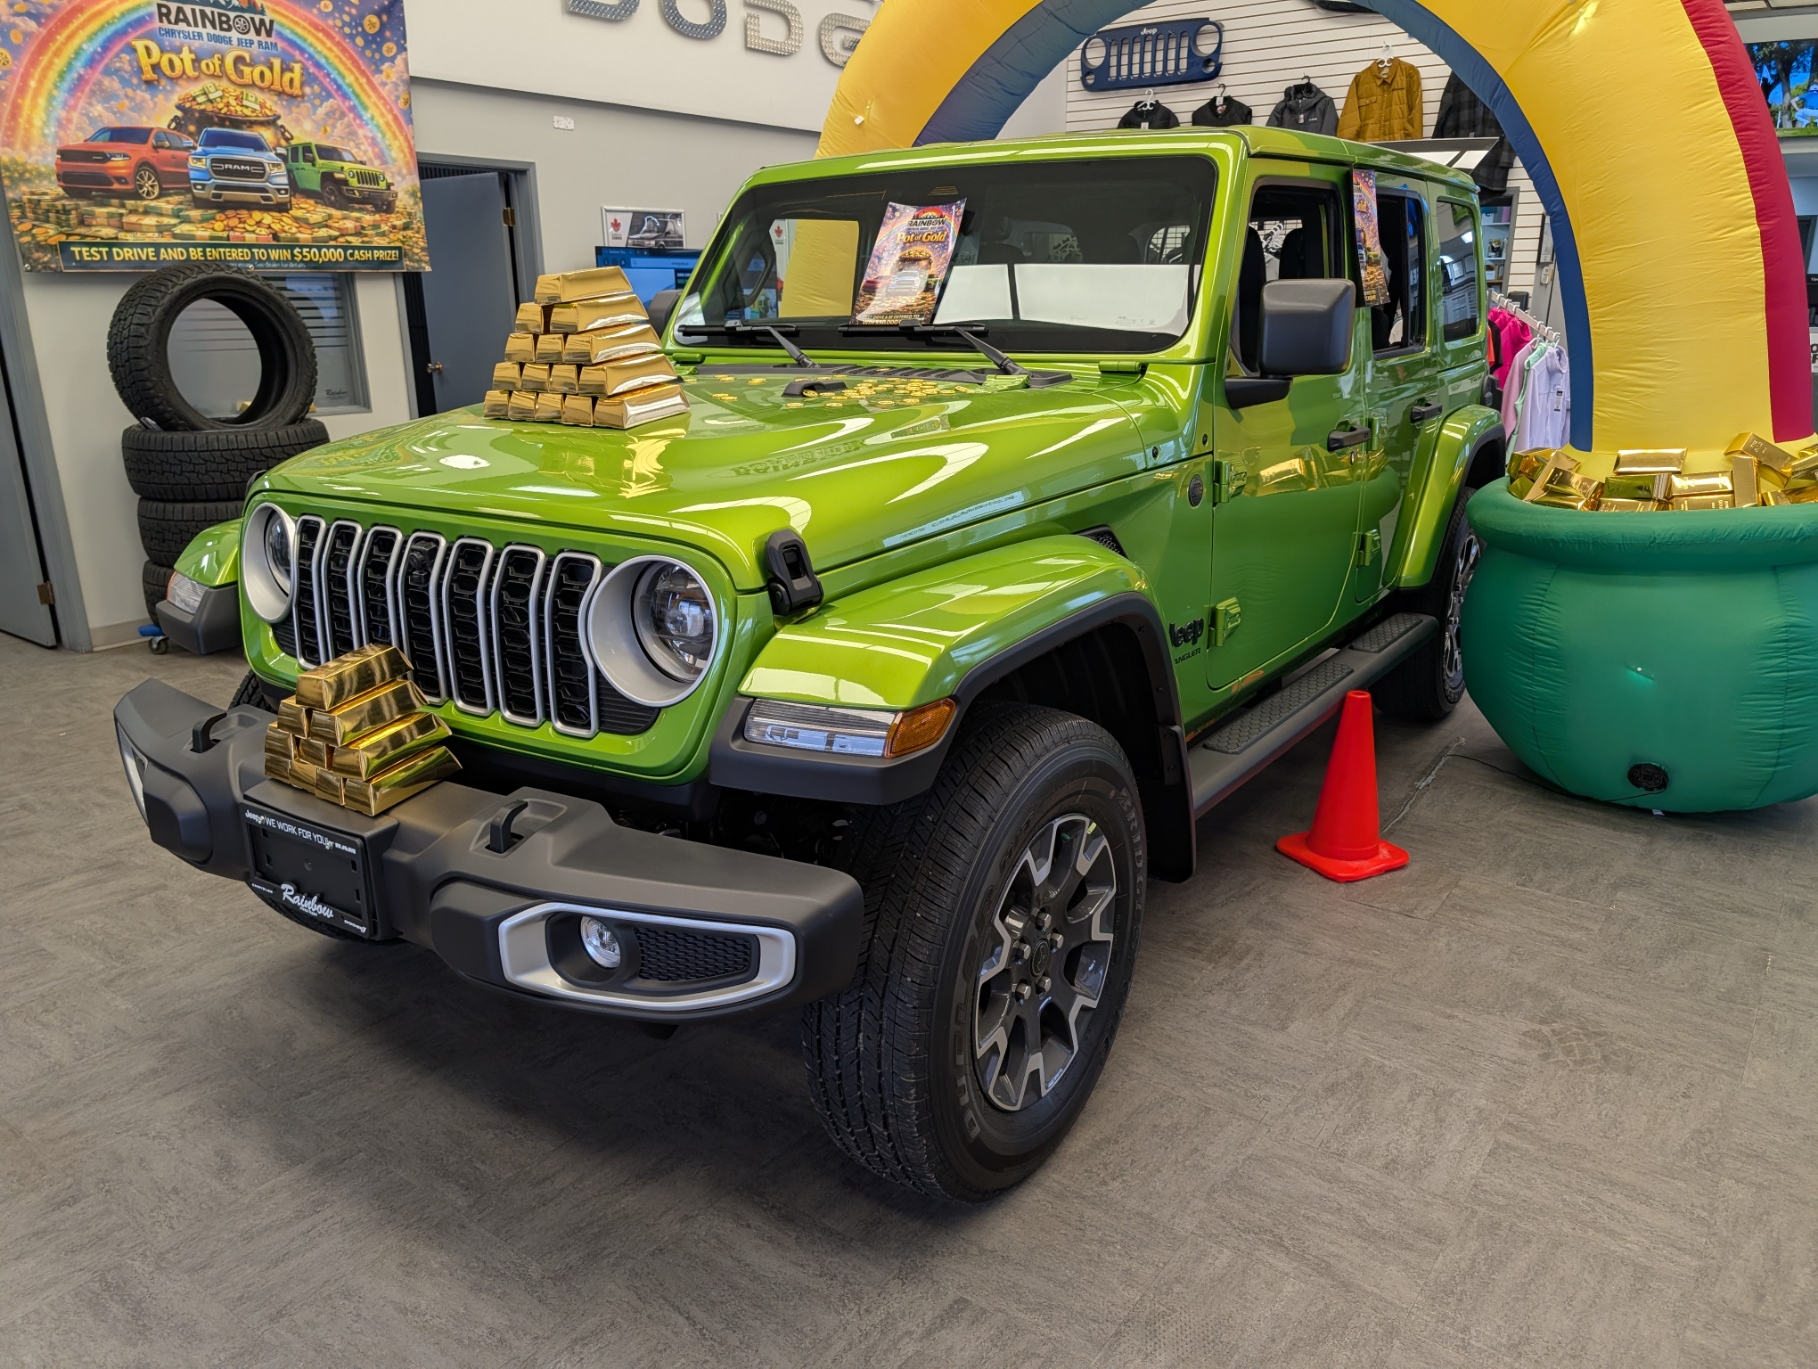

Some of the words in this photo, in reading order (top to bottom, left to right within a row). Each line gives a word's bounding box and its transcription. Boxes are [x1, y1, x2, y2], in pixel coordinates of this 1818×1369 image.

[156, 2, 275, 38] RAINBOW
[1140, 27, 1158, 36] Jeep
[158, 27, 204, 42] CHRYSLER
[207, 34, 233, 46] DODGE
[236, 37, 255, 49] JEEP
[257, 40, 279, 52] RAM
[567, 0, 873, 69] ODG
[131, 38, 200, 82] Pot
[200, 53, 223, 77] of
[224, 48, 303, 97] Gold
[224, 163, 250, 171] RAM
[907, 219, 947, 227] RAINBOW
[896, 232, 915, 244] Pot
[921, 231, 947, 243] Gold
[70, 246, 109, 261] TEST
[112, 247, 157, 261] DRIVE
[159, 247, 187, 261] AND
[189, 247, 205, 261] BE
[206, 248, 251, 261] ENTERED
[252, 248, 267, 261] TO
[268, 248, 291, 261] WIN
[293, 246, 345, 264] $50,000
[346, 249, 373, 261] CASH
[373, 249, 399, 261] PRIZE!
[265, 816, 277, 829] WE
[276, 820, 298, 836] WORK
[298, 828, 313, 841] FOR
[281, 883, 335, 919] Rainbow
